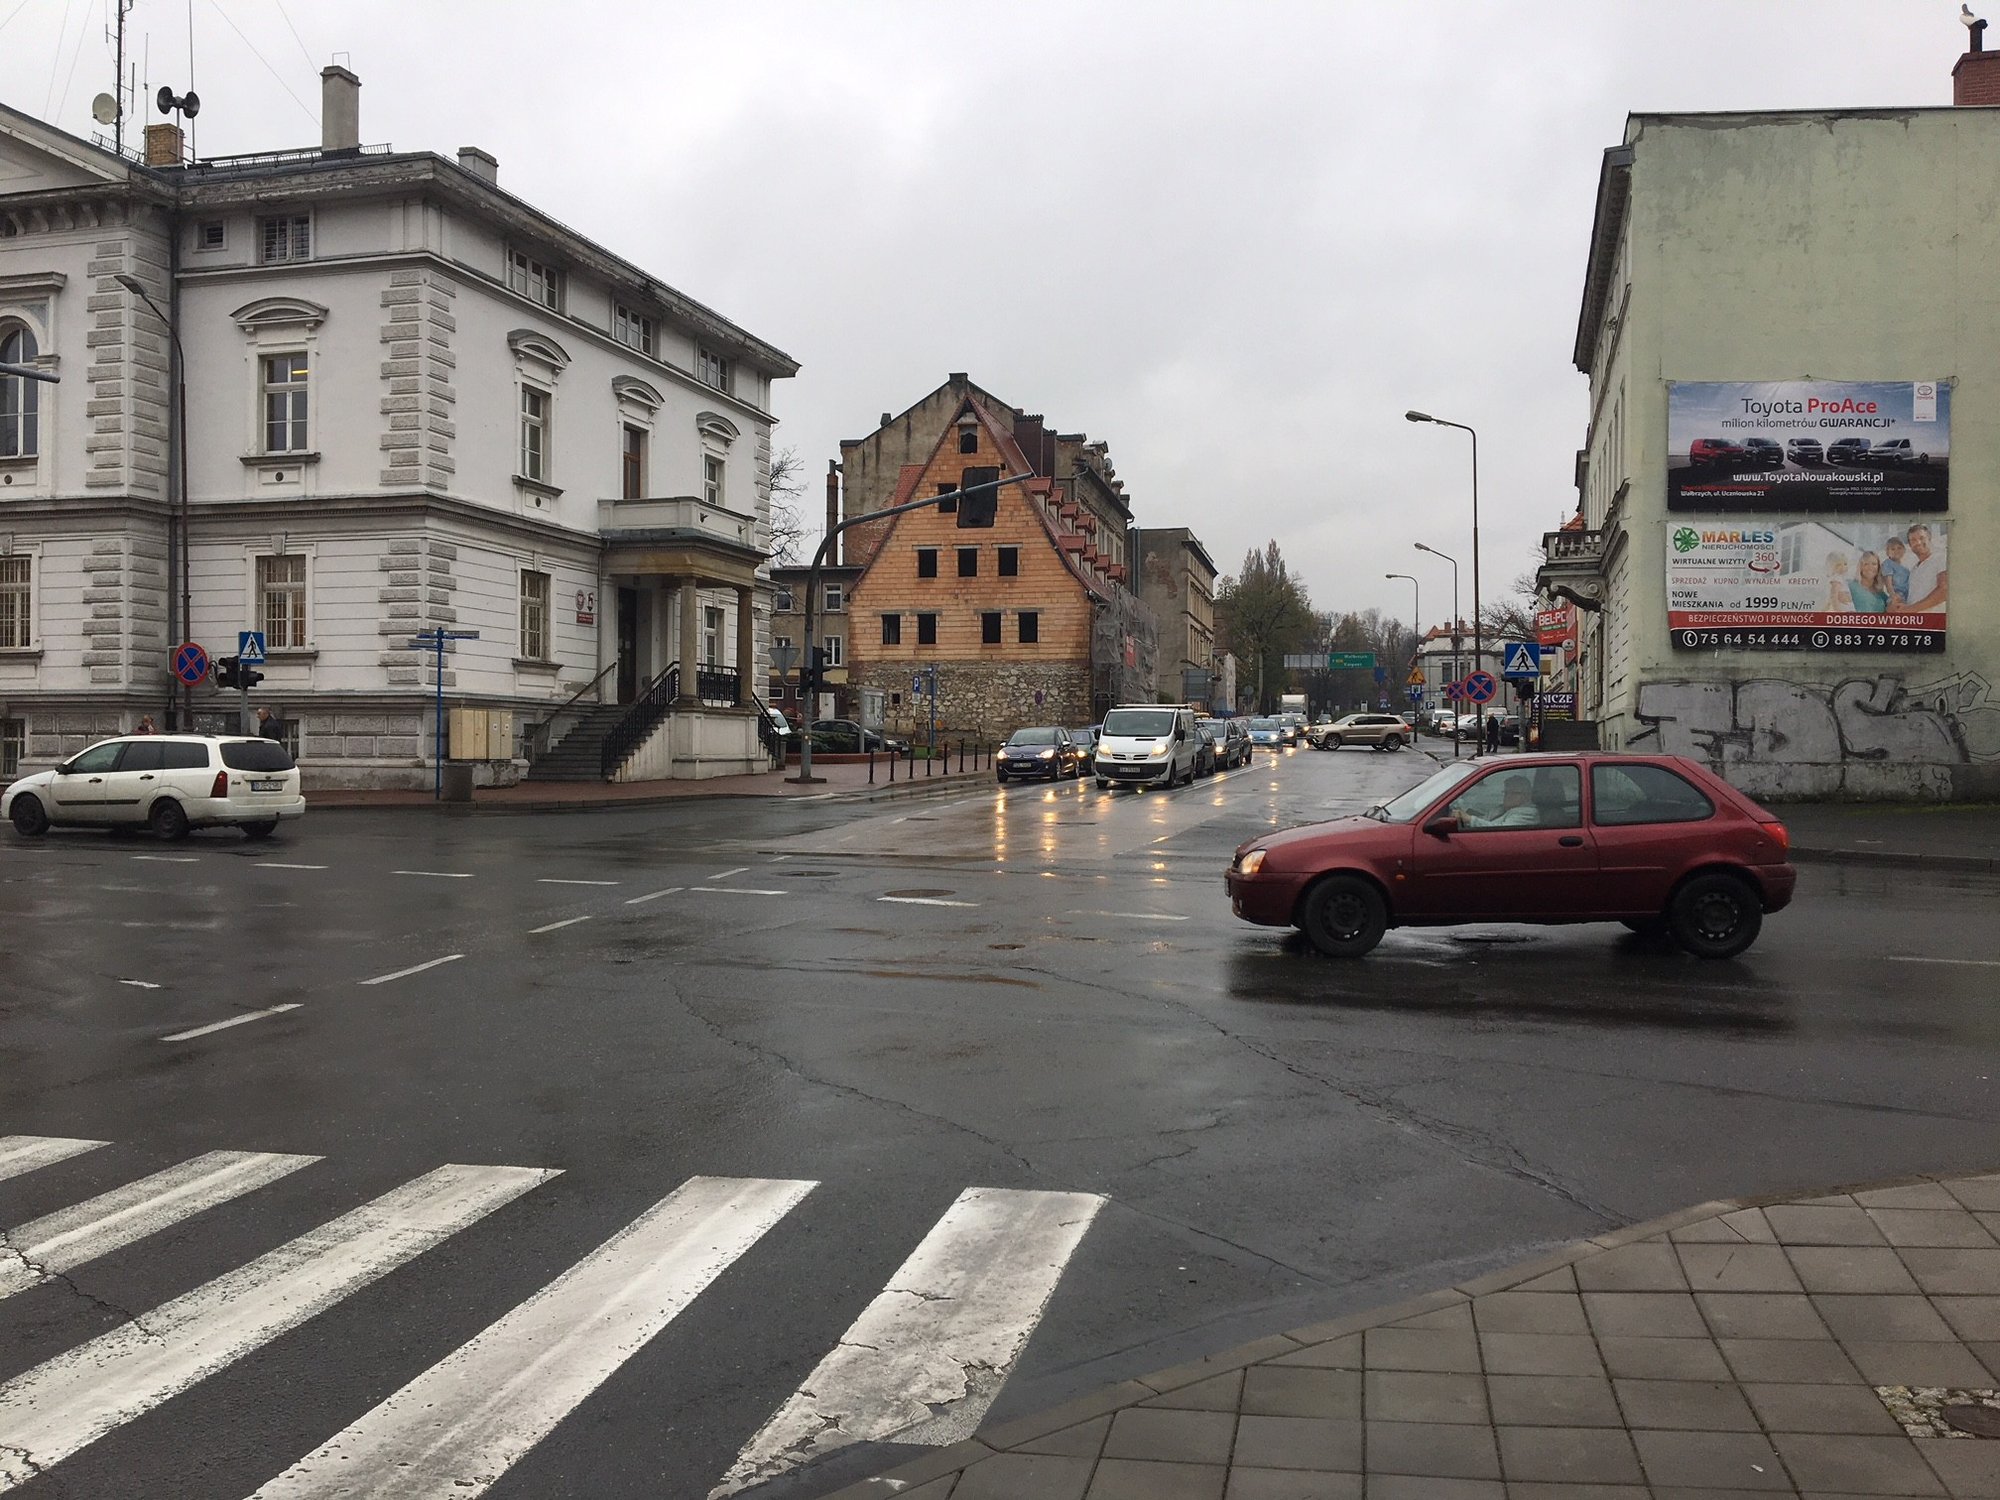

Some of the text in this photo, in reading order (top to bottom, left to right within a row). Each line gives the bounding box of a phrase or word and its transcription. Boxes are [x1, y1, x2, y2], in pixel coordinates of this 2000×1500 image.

[1741, 398, 1877, 417] Toyota ProAce
[1721, 418, 1755, 428] milion
[1757, 417, 1817, 428] kilometrów
[1733, 472, 1883, 484] www.ToyotaNowakowski.pl
[1702, 531, 1775, 543] MARLES
[1702, 543, 1774, 551] NIERUCHOMOŚCI
[1671, 577, 1820, 585] SPRZEDAŻ KUPNO WYNAJEM KREDYTY
[1672, 590, 1698, 598] NOWE
[1672, 600, 1724, 608] MIESZKANIA
[1730, 600, 1741, 609] od
[1745, 596, 1779, 609] 1999
[1688, 613, 1764, 623] BEZPIECZEŃSTWO
[1771, 613, 1815, 624] PEWNOŚĆ
[1826, 614, 1876, 625] DOBREGO
[1878, 615, 1924, 625] WYBORU
[1700, 633, 1800, 645] 75 64 54 444
[1834, 634, 1932, 646] 883 79 78 78
[1427, 701, 1434, 709] P
